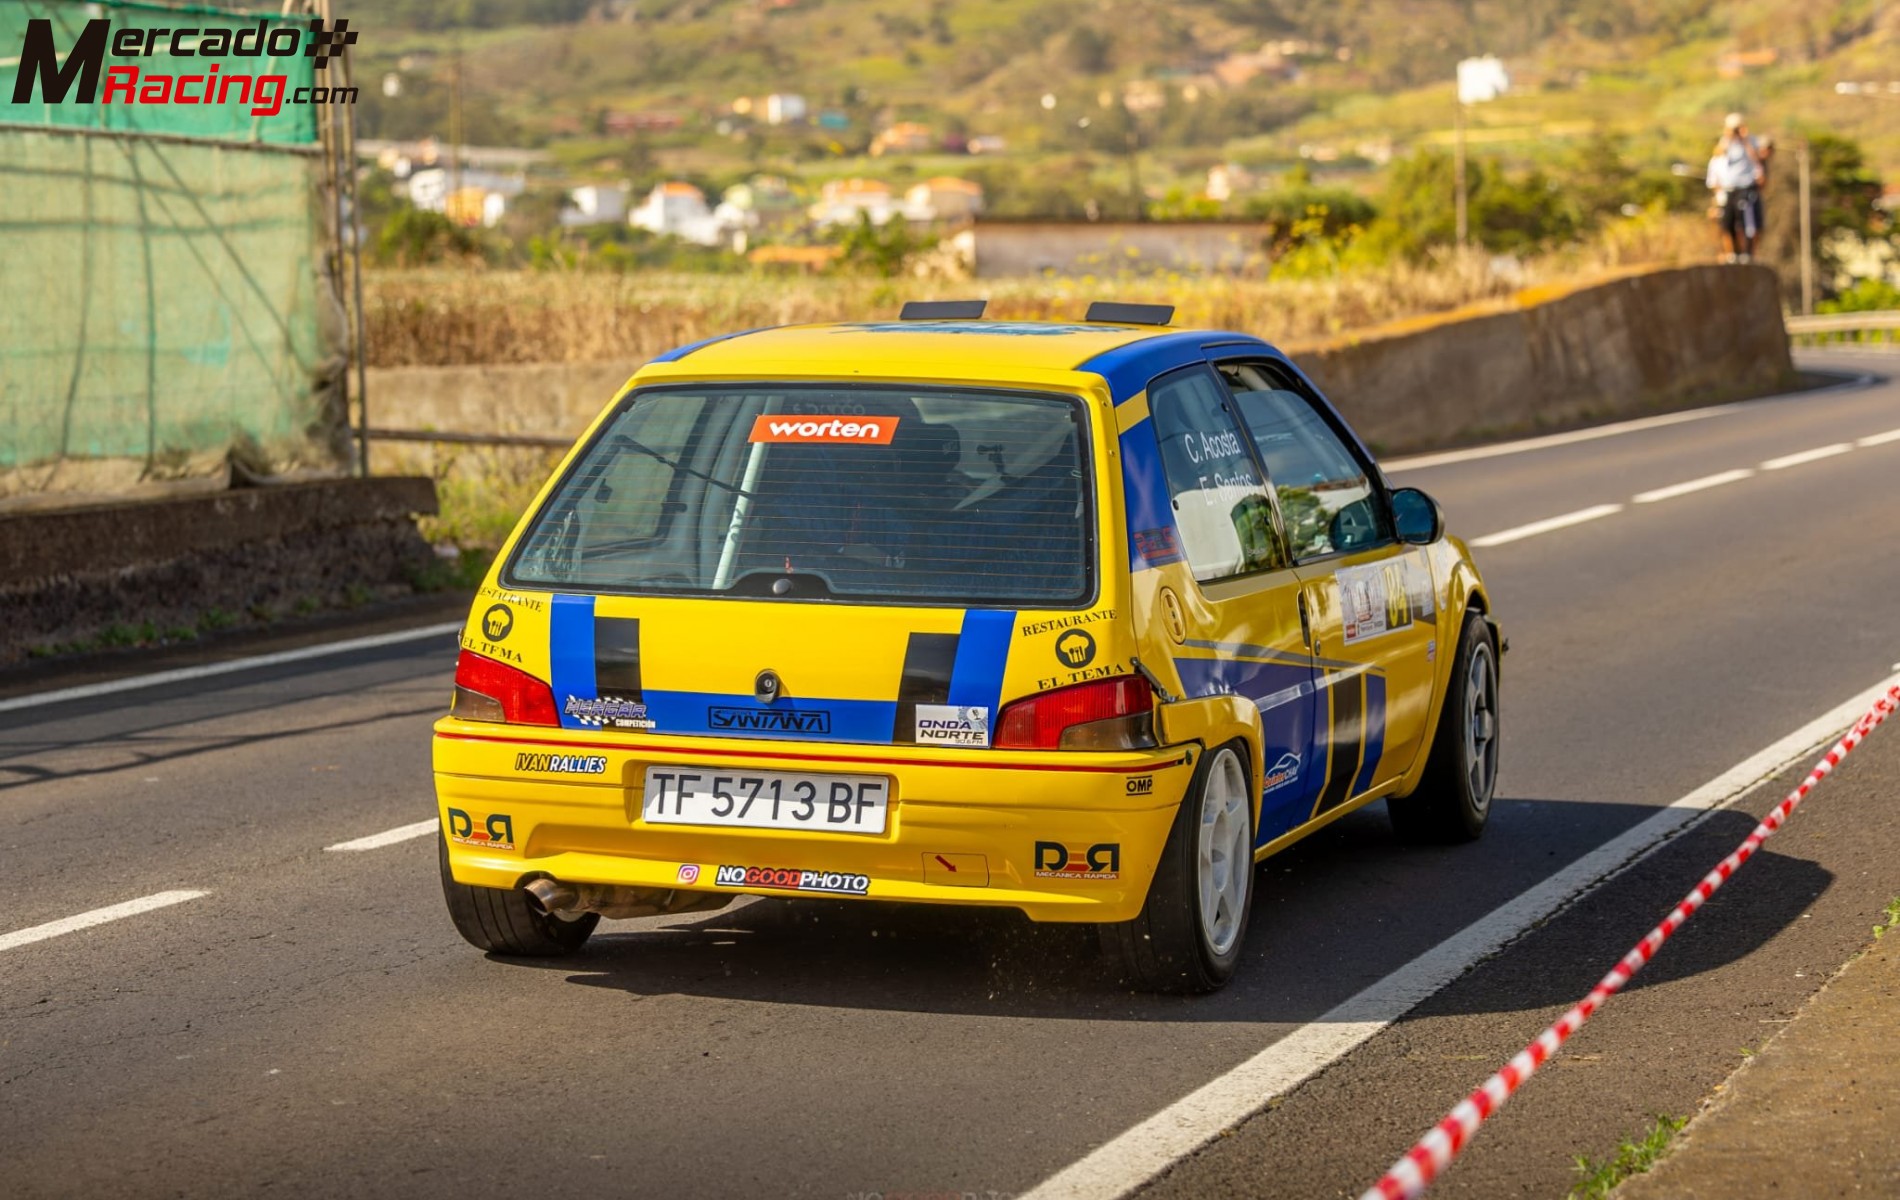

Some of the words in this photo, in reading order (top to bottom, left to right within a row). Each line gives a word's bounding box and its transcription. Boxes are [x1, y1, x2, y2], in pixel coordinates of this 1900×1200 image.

[769, 420, 880, 438] worten
[1185, 433, 1203, 463] C.
[1200, 429, 1241, 461] Acosta
[1022, 609, 1118, 637] RESTAURANTE
[463, 636, 477, 650] EL
[1037, 677, 1064, 690] EL
[1068, 663, 1125, 683] TEMA
[713, 710, 824, 731] SANTANA
[918, 720, 972, 730] ONDA
[920, 730, 985, 740] NORTE
[1126, 778, 1153, 793] OMP
[652, 773, 701, 815] TF
[711, 777, 817, 821] 5713
[827, 782, 882, 824] BF
[716, 866, 870, 893] NOGOODPHOTO
[1036, 871, 1082, 879] MECANICA
